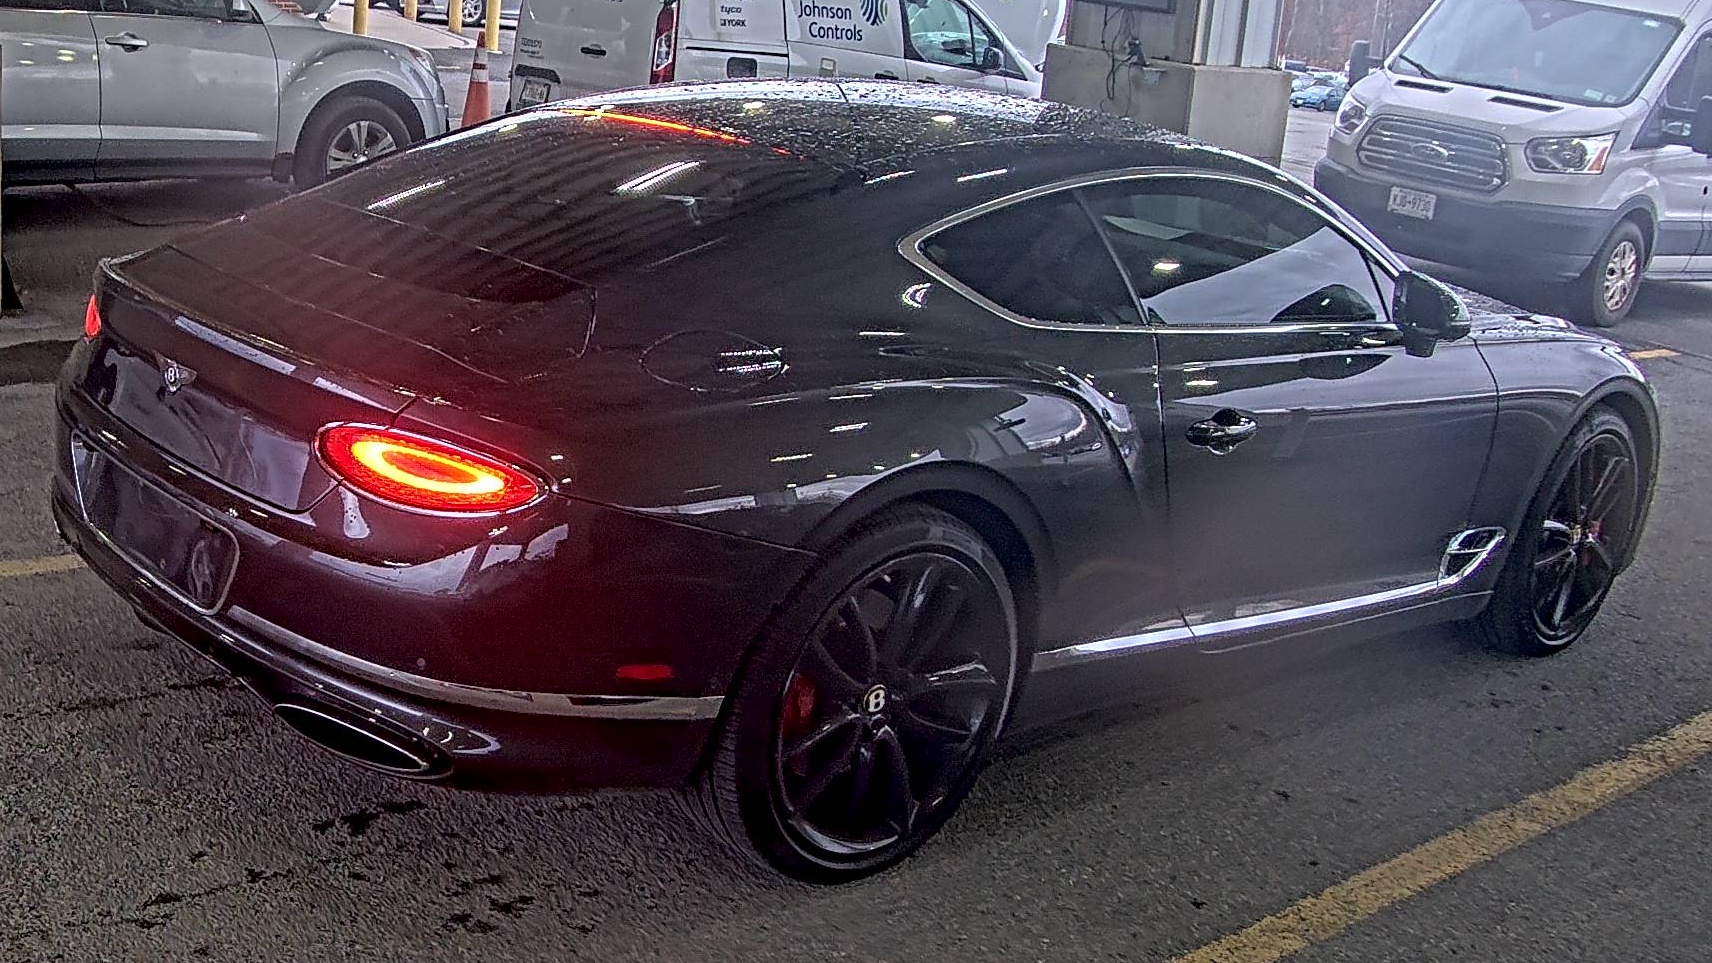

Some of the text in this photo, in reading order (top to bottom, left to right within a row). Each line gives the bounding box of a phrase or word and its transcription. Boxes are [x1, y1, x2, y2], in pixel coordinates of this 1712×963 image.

[720, 5, 742, 15] tyco
[799, 0, 852, 20] Johnson
[727, 19, 746, 27] YORK
[809, 22, 862, 41] Controls
[868, 690, 885, 711] B
